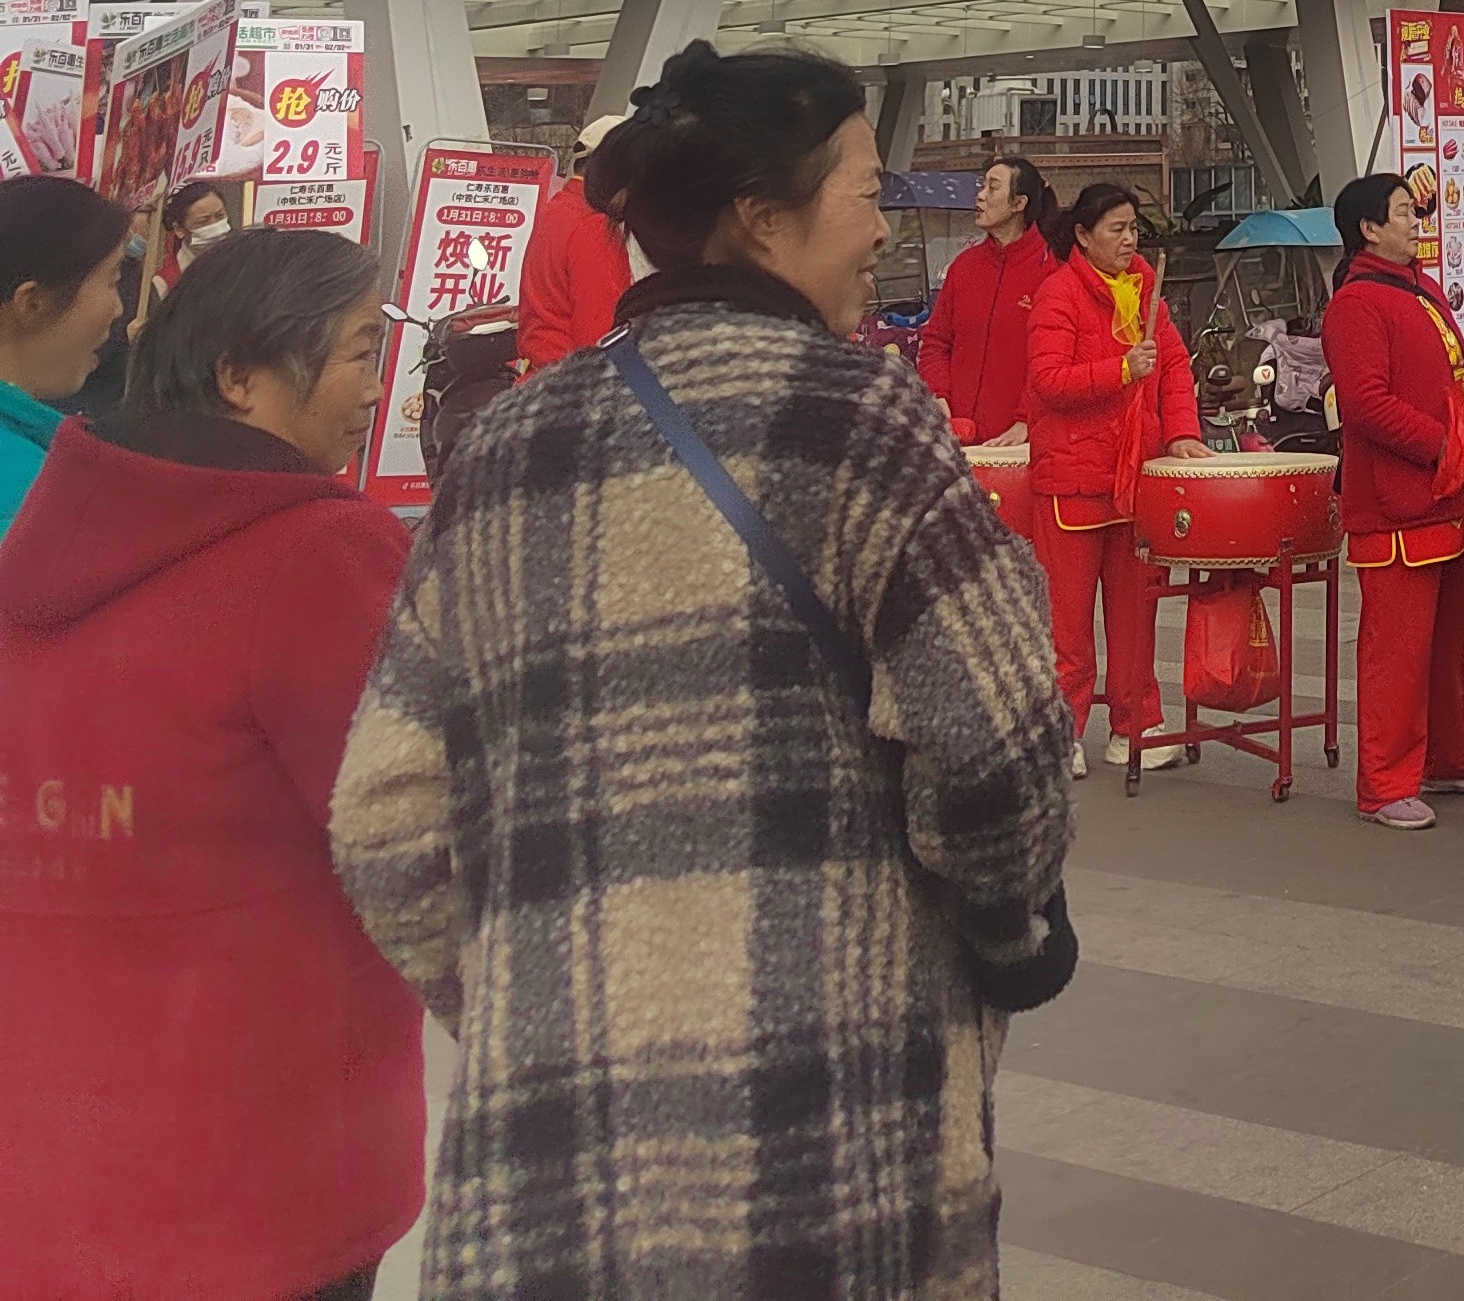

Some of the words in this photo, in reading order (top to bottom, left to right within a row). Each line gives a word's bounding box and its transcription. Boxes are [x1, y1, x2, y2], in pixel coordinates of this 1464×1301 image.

[275, 85, 362, 121] 抢购价
[265, 139, 320, 176] 2.9
[466, 183, 509, 195] 仁寿乐百惠
[434, 229, 513, 273] 焕新
[427, 272, 508, 311] 开业
